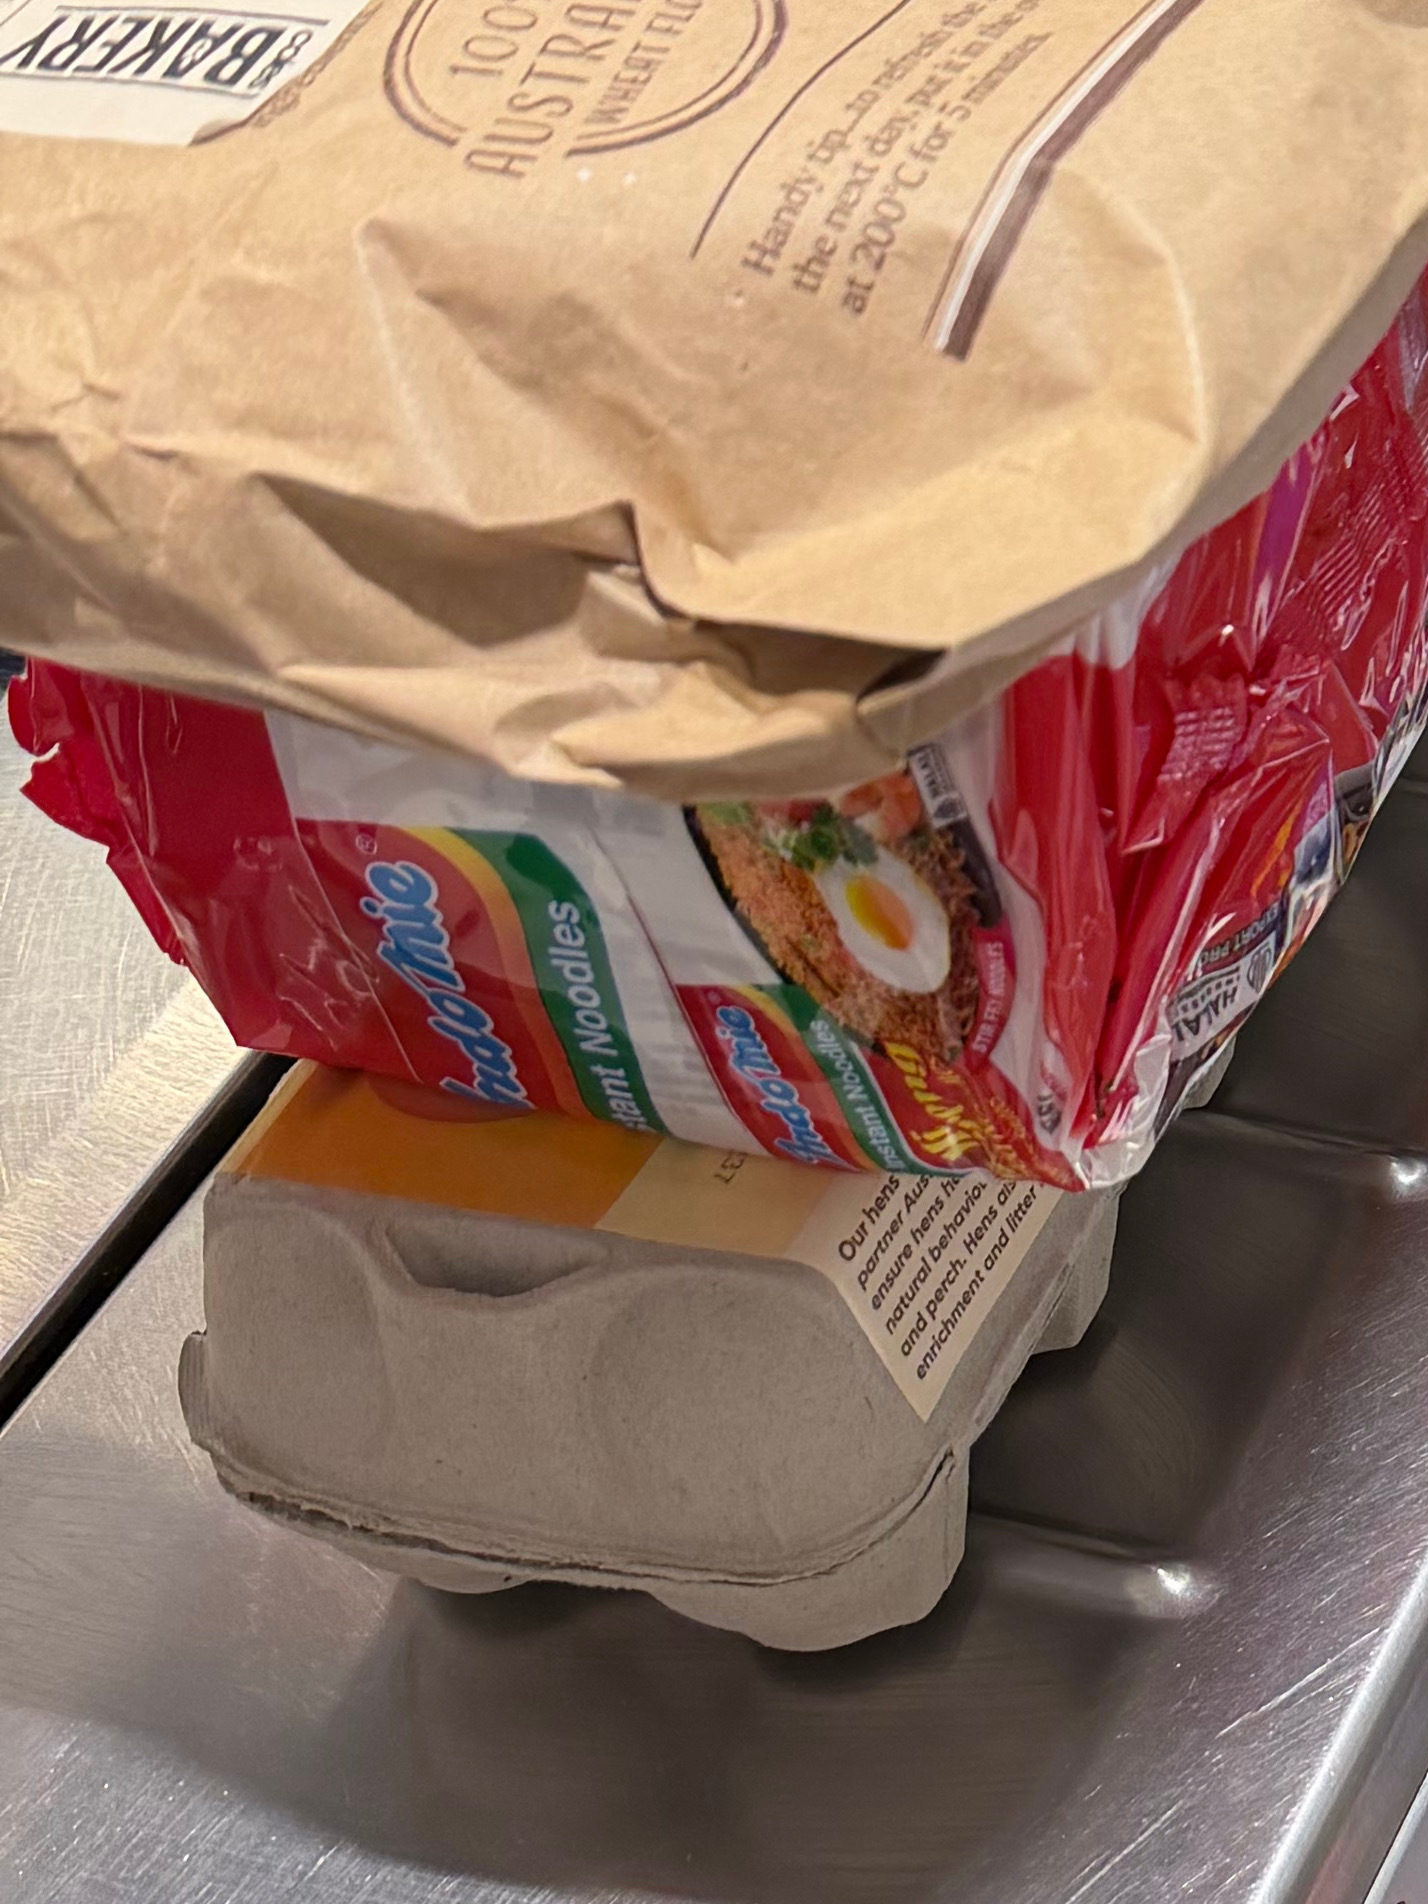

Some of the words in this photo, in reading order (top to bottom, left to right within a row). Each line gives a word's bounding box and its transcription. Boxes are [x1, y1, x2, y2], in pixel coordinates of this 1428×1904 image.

[0, 15, 287, 88] BAKERY
[583, 41, 670, 125] WHEAT
[547, 899, 625, 1059] Noodles
[838, 1222, 876, 1262] Our
[864, 1174, 901, 1226] hens
[916, 1269, 985, 1380] enrichment
[1007, 1185, 1037, 1234] litter
